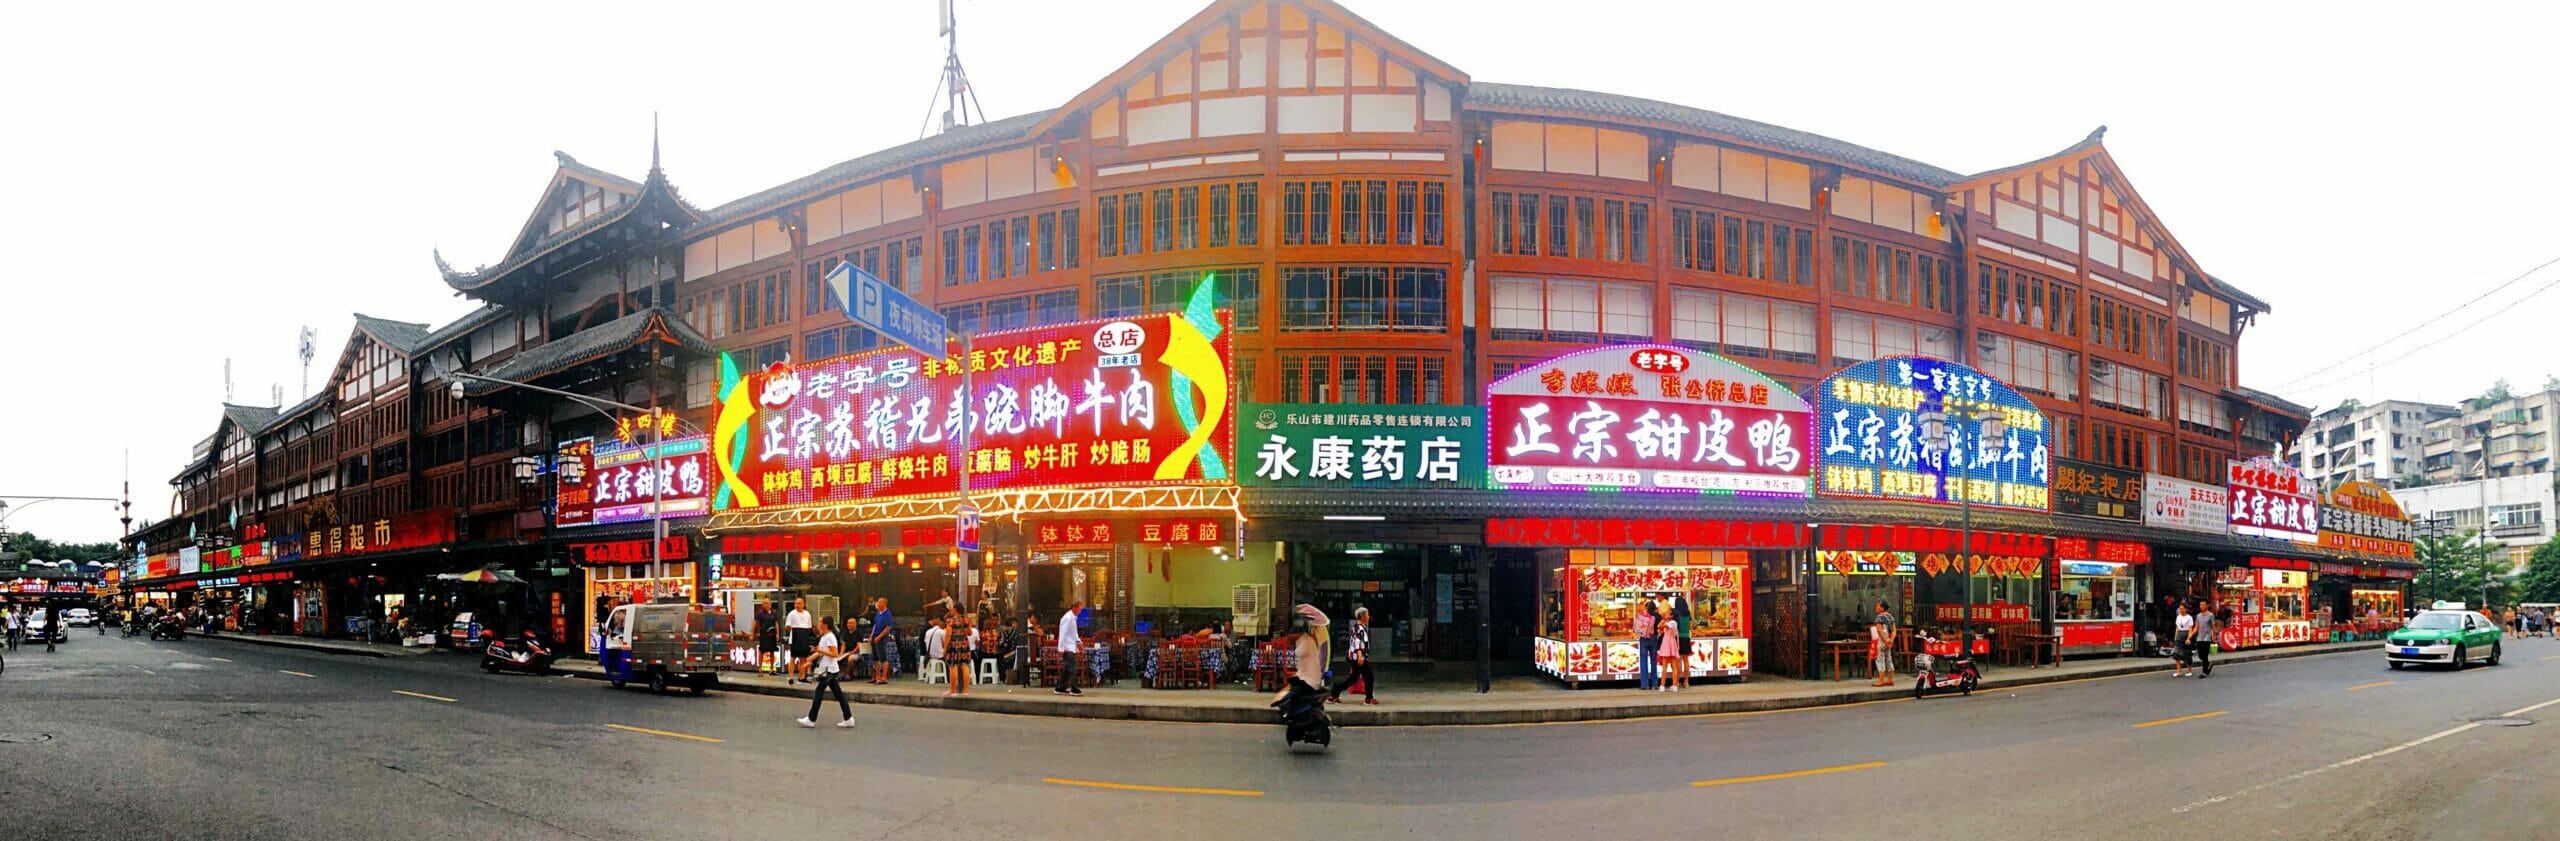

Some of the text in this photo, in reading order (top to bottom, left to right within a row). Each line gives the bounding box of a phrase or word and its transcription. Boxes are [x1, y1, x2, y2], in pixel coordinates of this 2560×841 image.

[889, 299, 943, 351] 夜市停车场
[1098, 329, 1140, 348] 总店
[807, 358, 917, 398] 老字号
[1101, 355, 1139, 366] 38年老店
[1637, 351, 1684, 372] 老字号
[1899, 360, 1991, 400] 第一家老字号
[1661, 376, 1769, 405] 张公桥总店
[761, 367, 1154, 461] 正宗苏稽兄弟跷脚牛肉
[1286, 413, 1472, 427] 乐山市建川药品零售连锁有限公司
[1507, 401, 1801, 472] 正宗甜皮鸭
[763, 469, 803, 492] 钵钵鸡
[811, 462, 872, 487] 西坝豆腐
[881, 453, 948, 481] 鲜烧牛肉
[1024, 443, 1079, 469] 炒牛肝
[1090, 438, 1150, 465] 炒脆肠
[1256, 434, 1461, 481] 永康药店
[594, 456, 704, 504] 正宗甜皮鸭
[2232, 490, 2318, 534] 正宗甜皮鸭
[1041, 524, 1110, 543] 钵钵鸡
[1143, 523, 1218, 542] 豆腐脑
